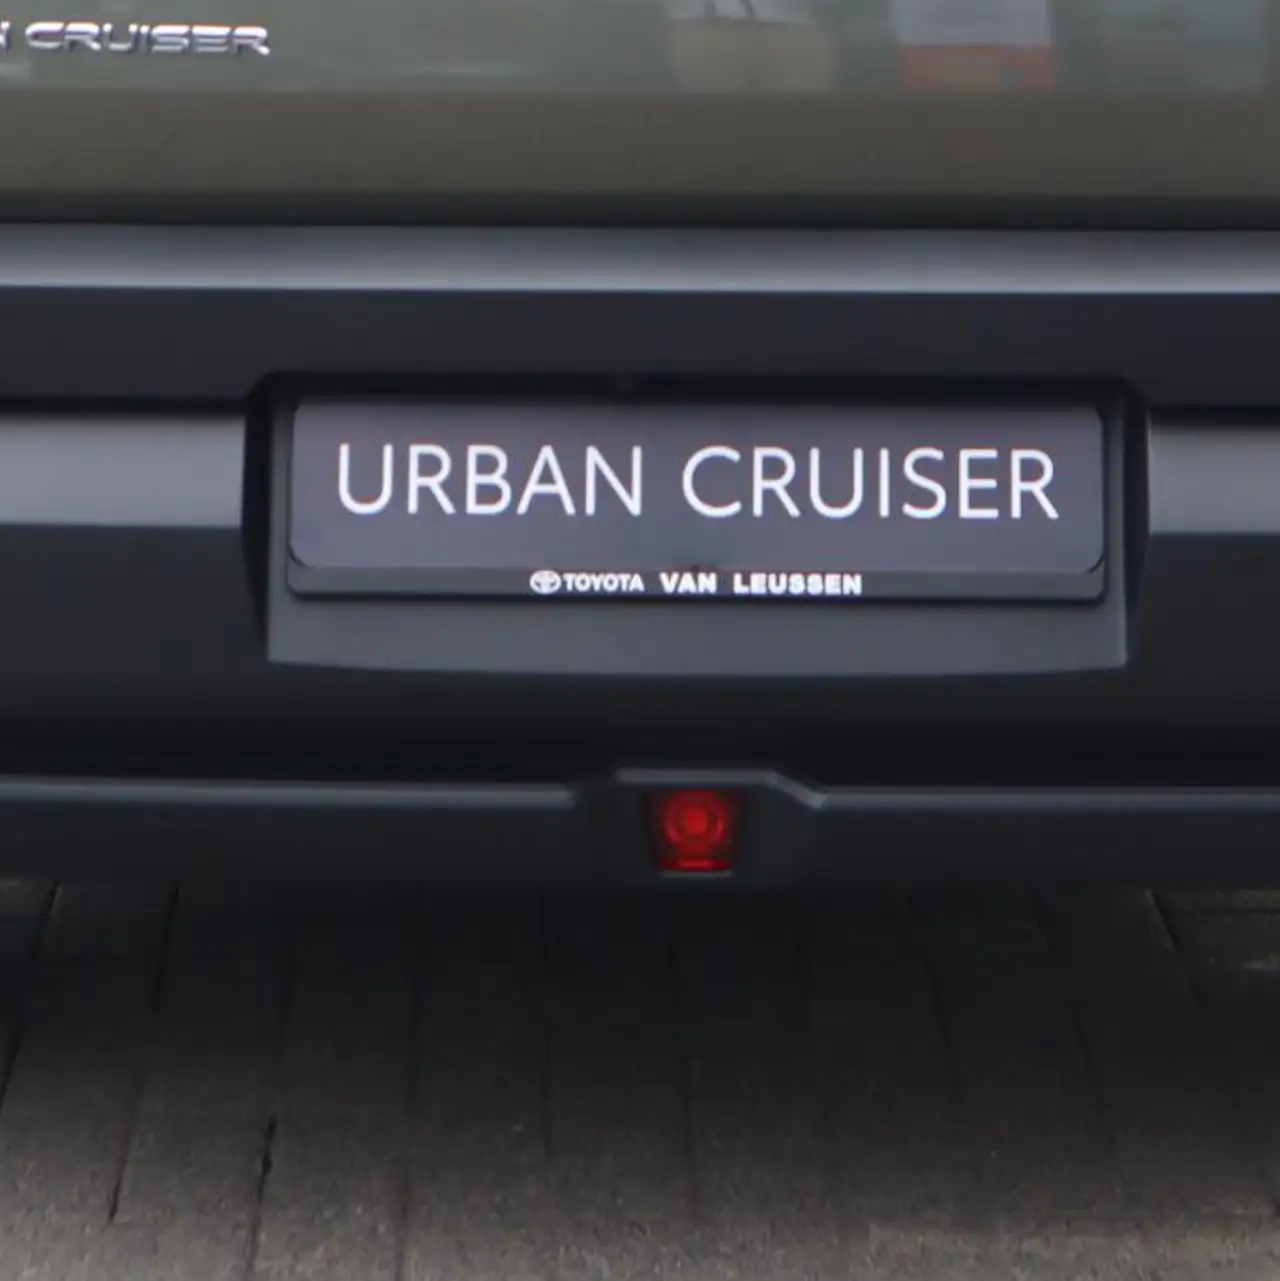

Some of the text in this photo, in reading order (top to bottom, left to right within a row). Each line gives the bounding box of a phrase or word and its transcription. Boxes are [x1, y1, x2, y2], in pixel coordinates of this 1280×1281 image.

[25, 22, 270, 55] CRUISER
[338, 444, 1059, 520] URBAN CRUISER
[564, 572, 862, 595] TOYOTA VAN LEUSSEN
